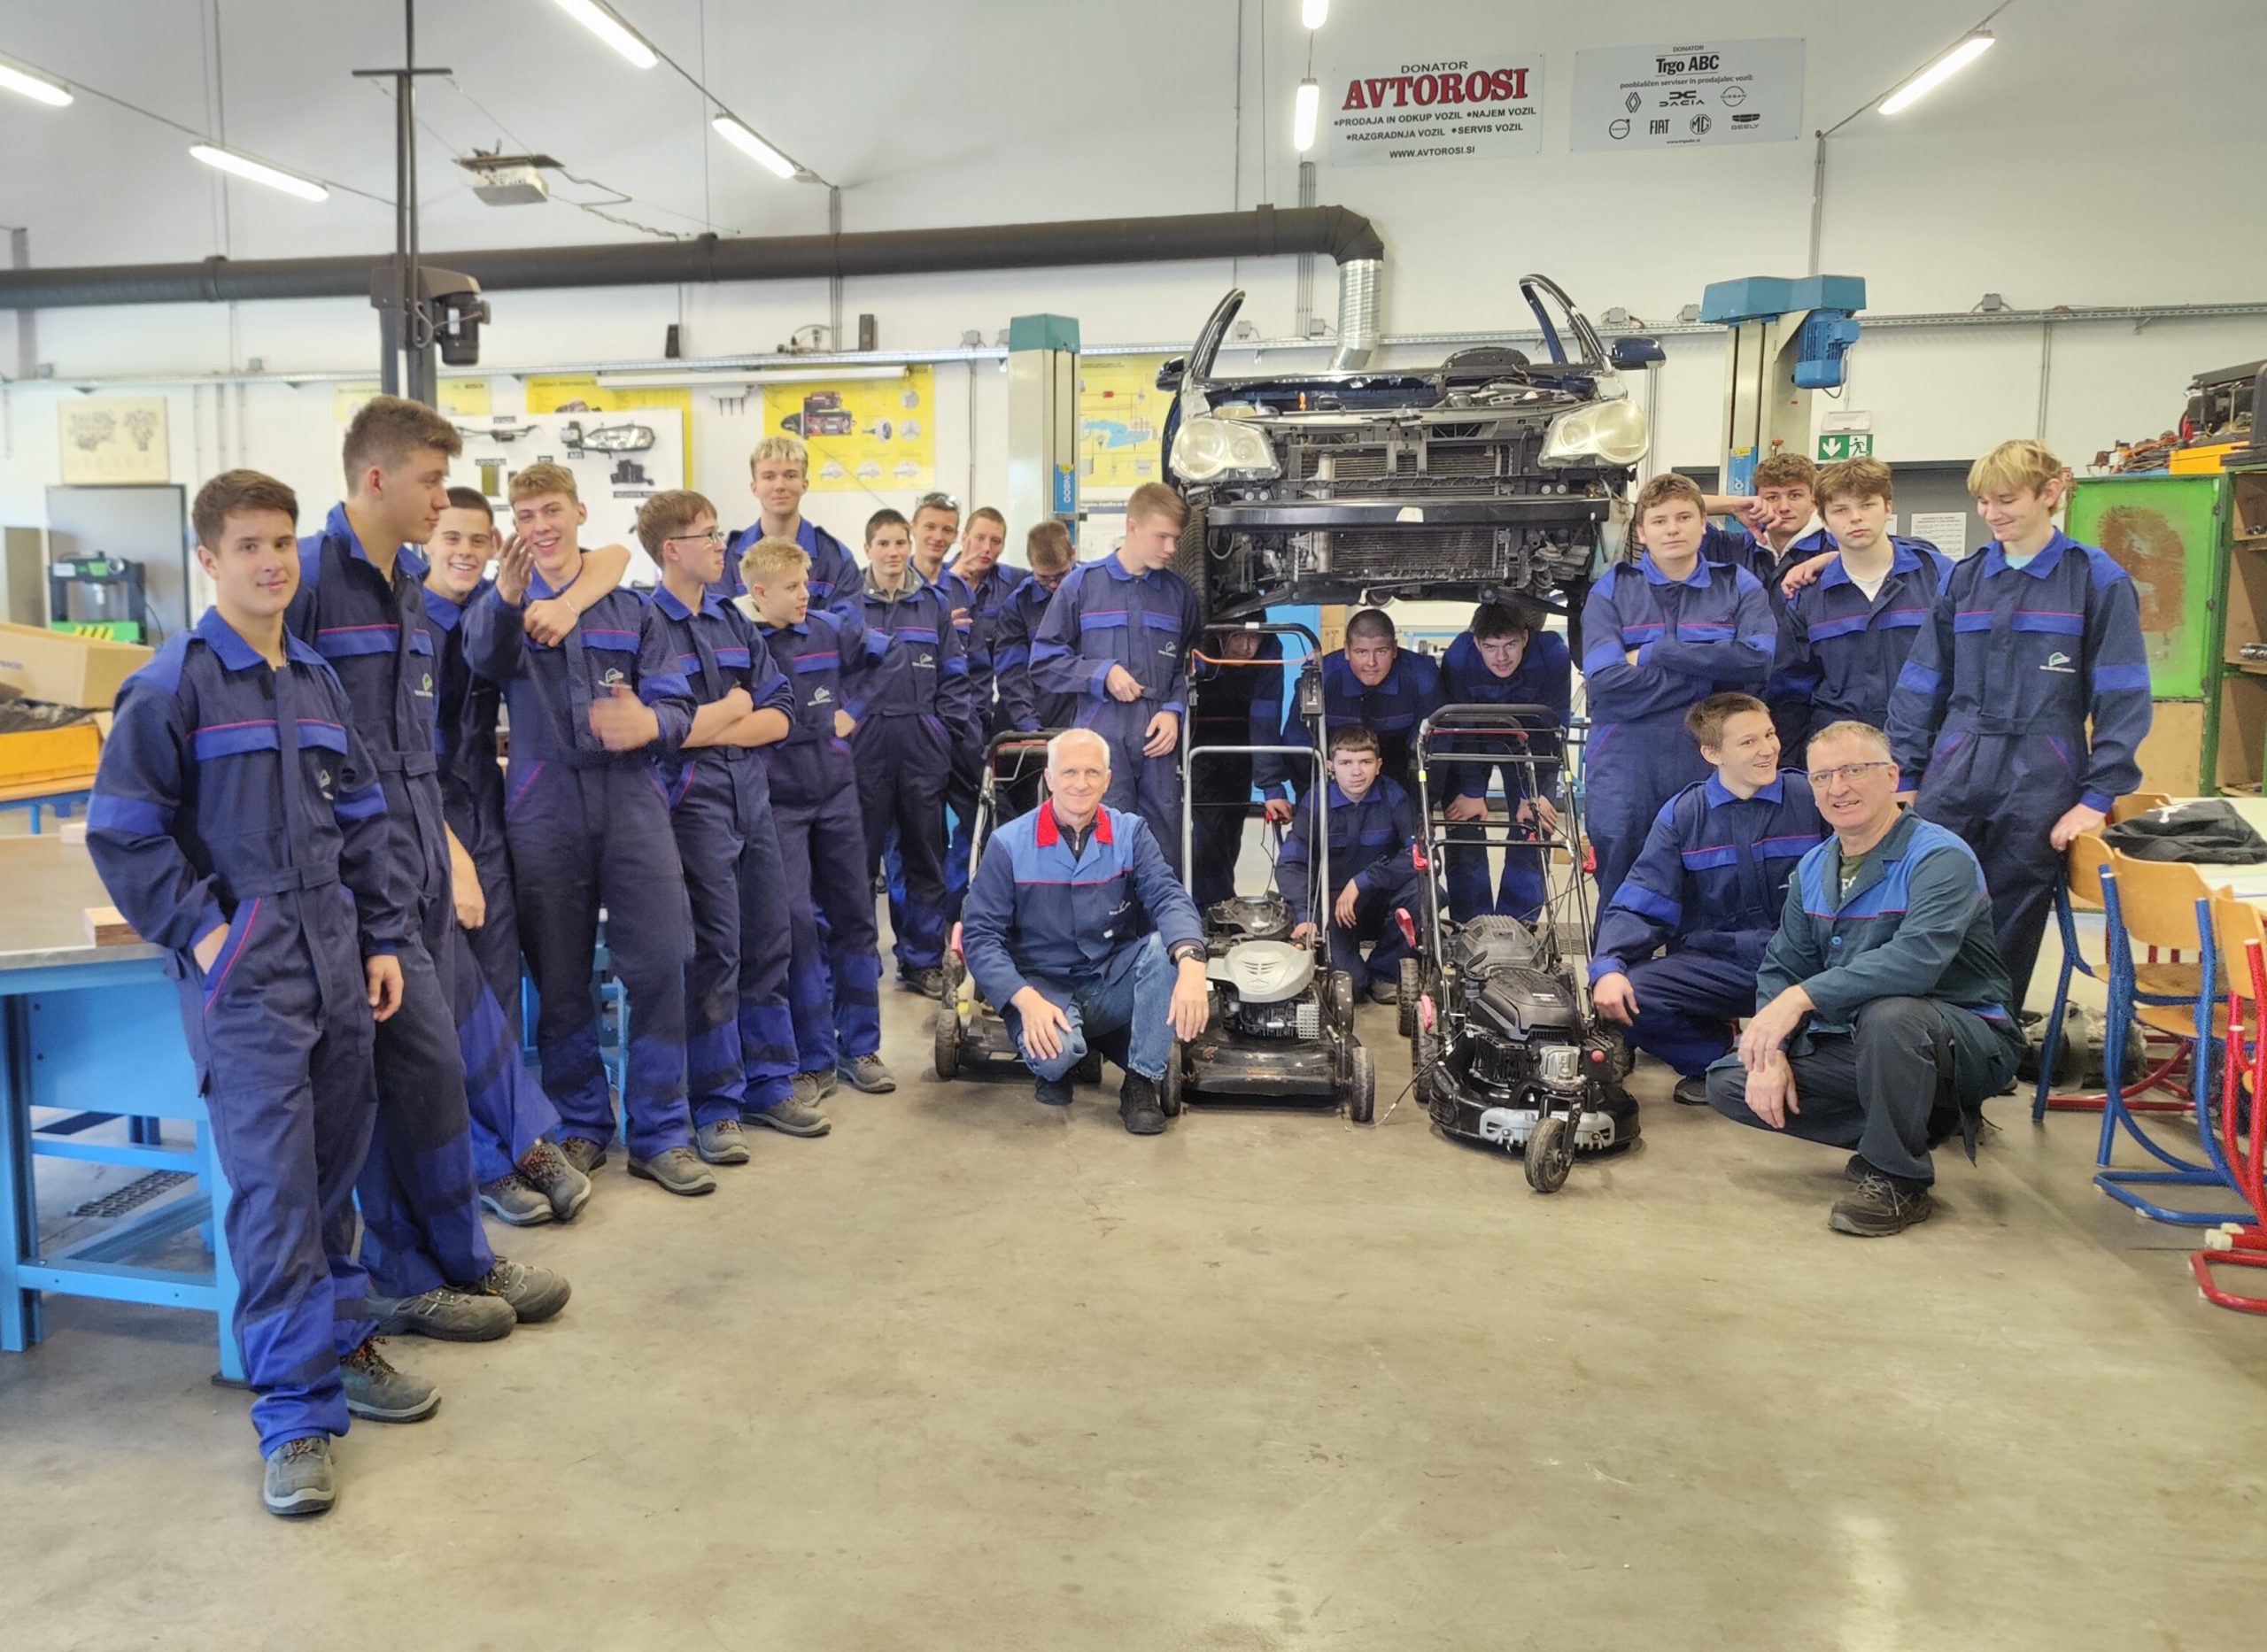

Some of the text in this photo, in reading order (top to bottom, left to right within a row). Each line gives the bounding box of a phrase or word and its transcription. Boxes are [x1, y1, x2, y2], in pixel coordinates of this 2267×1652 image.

[1401, 61, 1468, 73] DONATOR
[1656, 55, 1720, 75] Trgo ABC
[1698, 75, 1734, 85] prodajalec
[1342, 68, 1528, 110] AVTOROSI
[1339, 112, 1463, 127] PRODAJA IN ODKUP VOZIL
[1472, 107, 1536, 119] NAJEM VOZIL
[1458, 123, 1523, 135] SERVIS VOZIL
[1650, 120, 1670, 135] FIAT
[1691, 116, 1711, 133] MG
[1351, 128, 1445, 142] RAZGRADNJA VOZIL
[1389, 146, 1475, 158] WWW.AVTOROSI.SI
